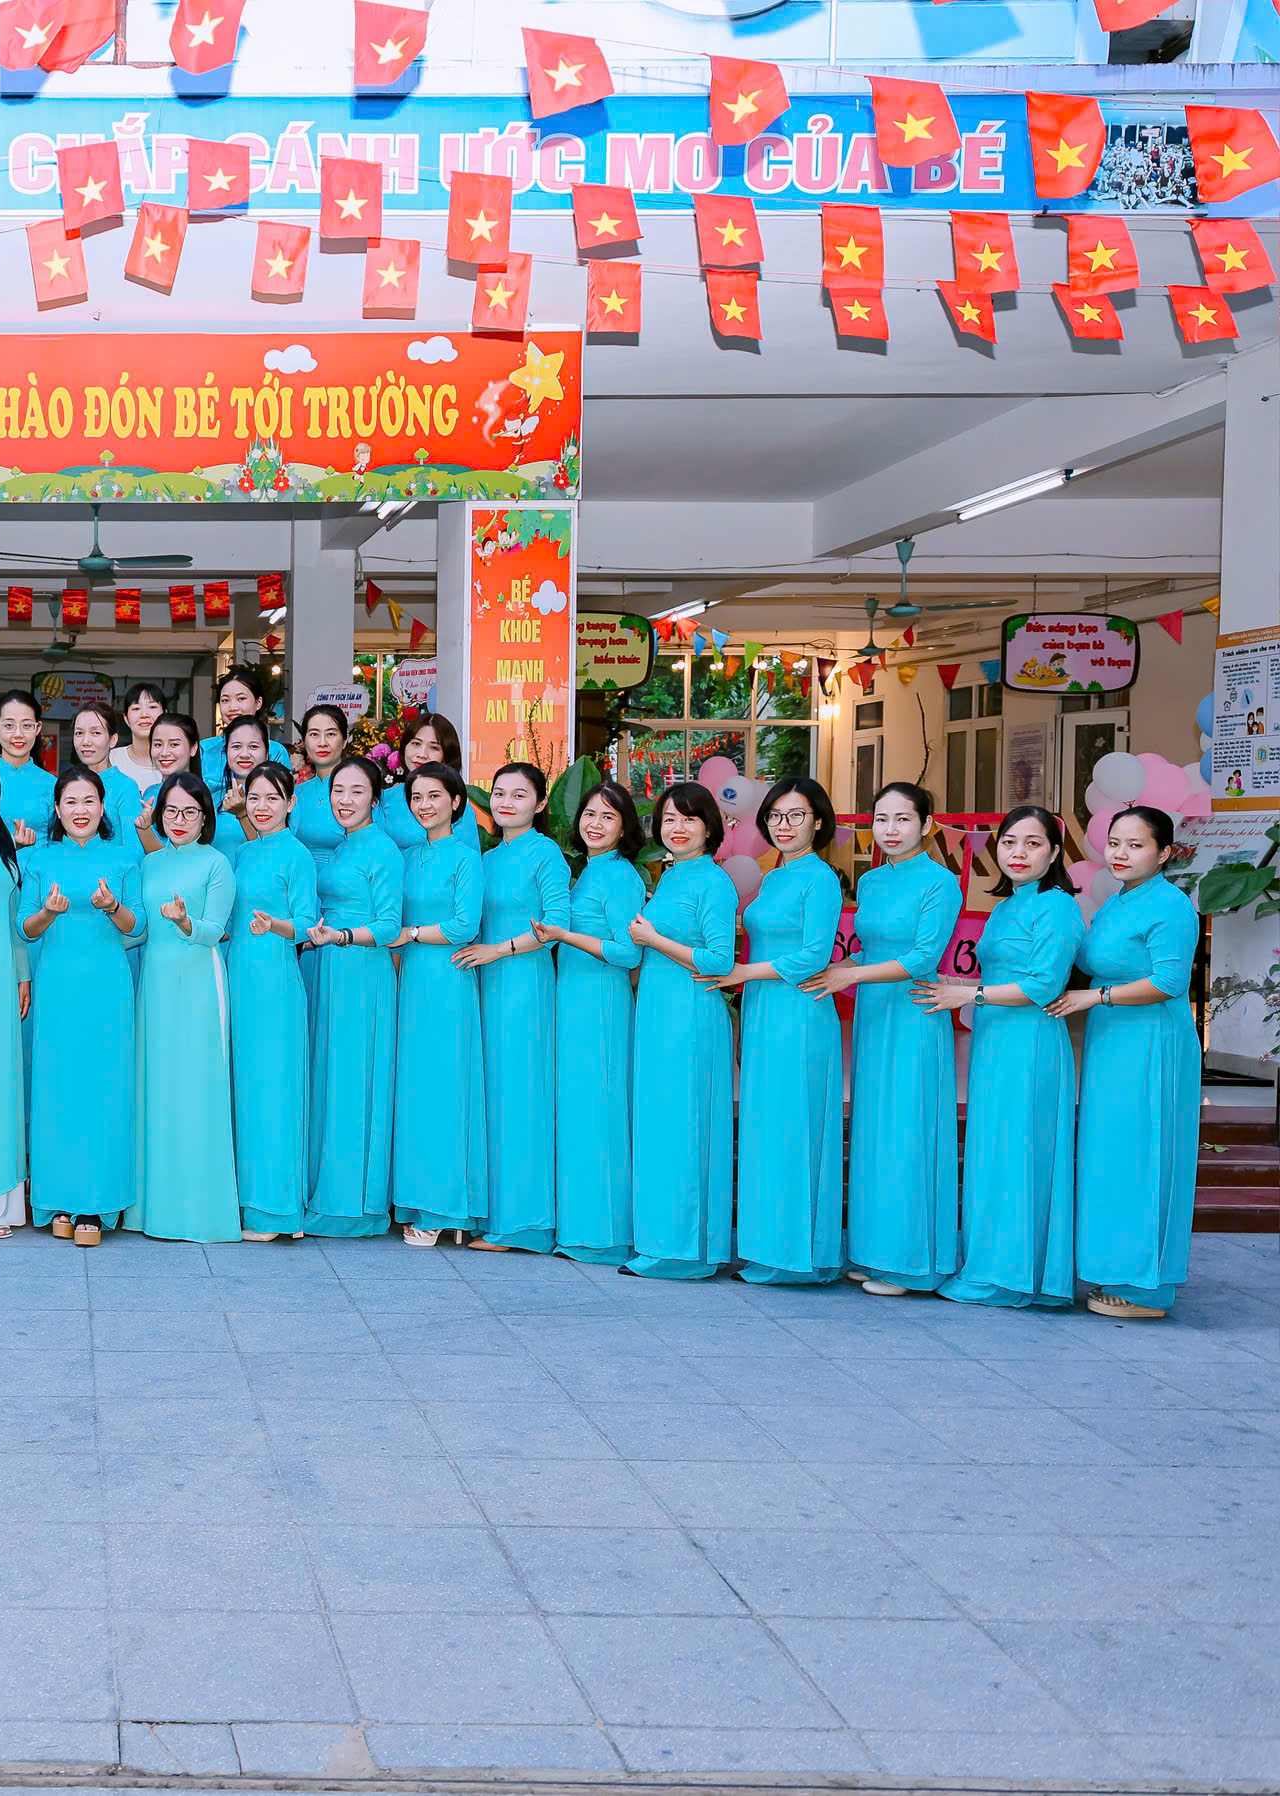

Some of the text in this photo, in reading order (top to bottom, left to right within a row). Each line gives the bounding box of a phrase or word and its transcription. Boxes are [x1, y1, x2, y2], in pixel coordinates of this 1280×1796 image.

[8, 112, 190, 194] CẮP
[743, 113, 893, 194] CỦA
[84, 371, 164, 439] ĐÓN
[174, 371, 221, 438] BÉ
[231, 371, 294, 439] TỚI
[303, 370, 460, 438] TRƯỜNG
[511, 574, 532, 603] BÉ
[500, 612, 542, 643] KHỎE
[586, 621, 616, 633] tượng
[1048, 622, 1076, 636] sáng
[1078, 623, 1098, 635] tạo
[577, 636, 607, 649] trọng
[1042, 639, 1105, 652] của bạn là
[617, 654, 640, 664] thức
[1090, 657, 1131, 669] vô hạn
[496, 659, 544, 688] MẠNH
[485, 694, 553, 722] AN TOÀN
[510, 734, 529, 762] LÀ
